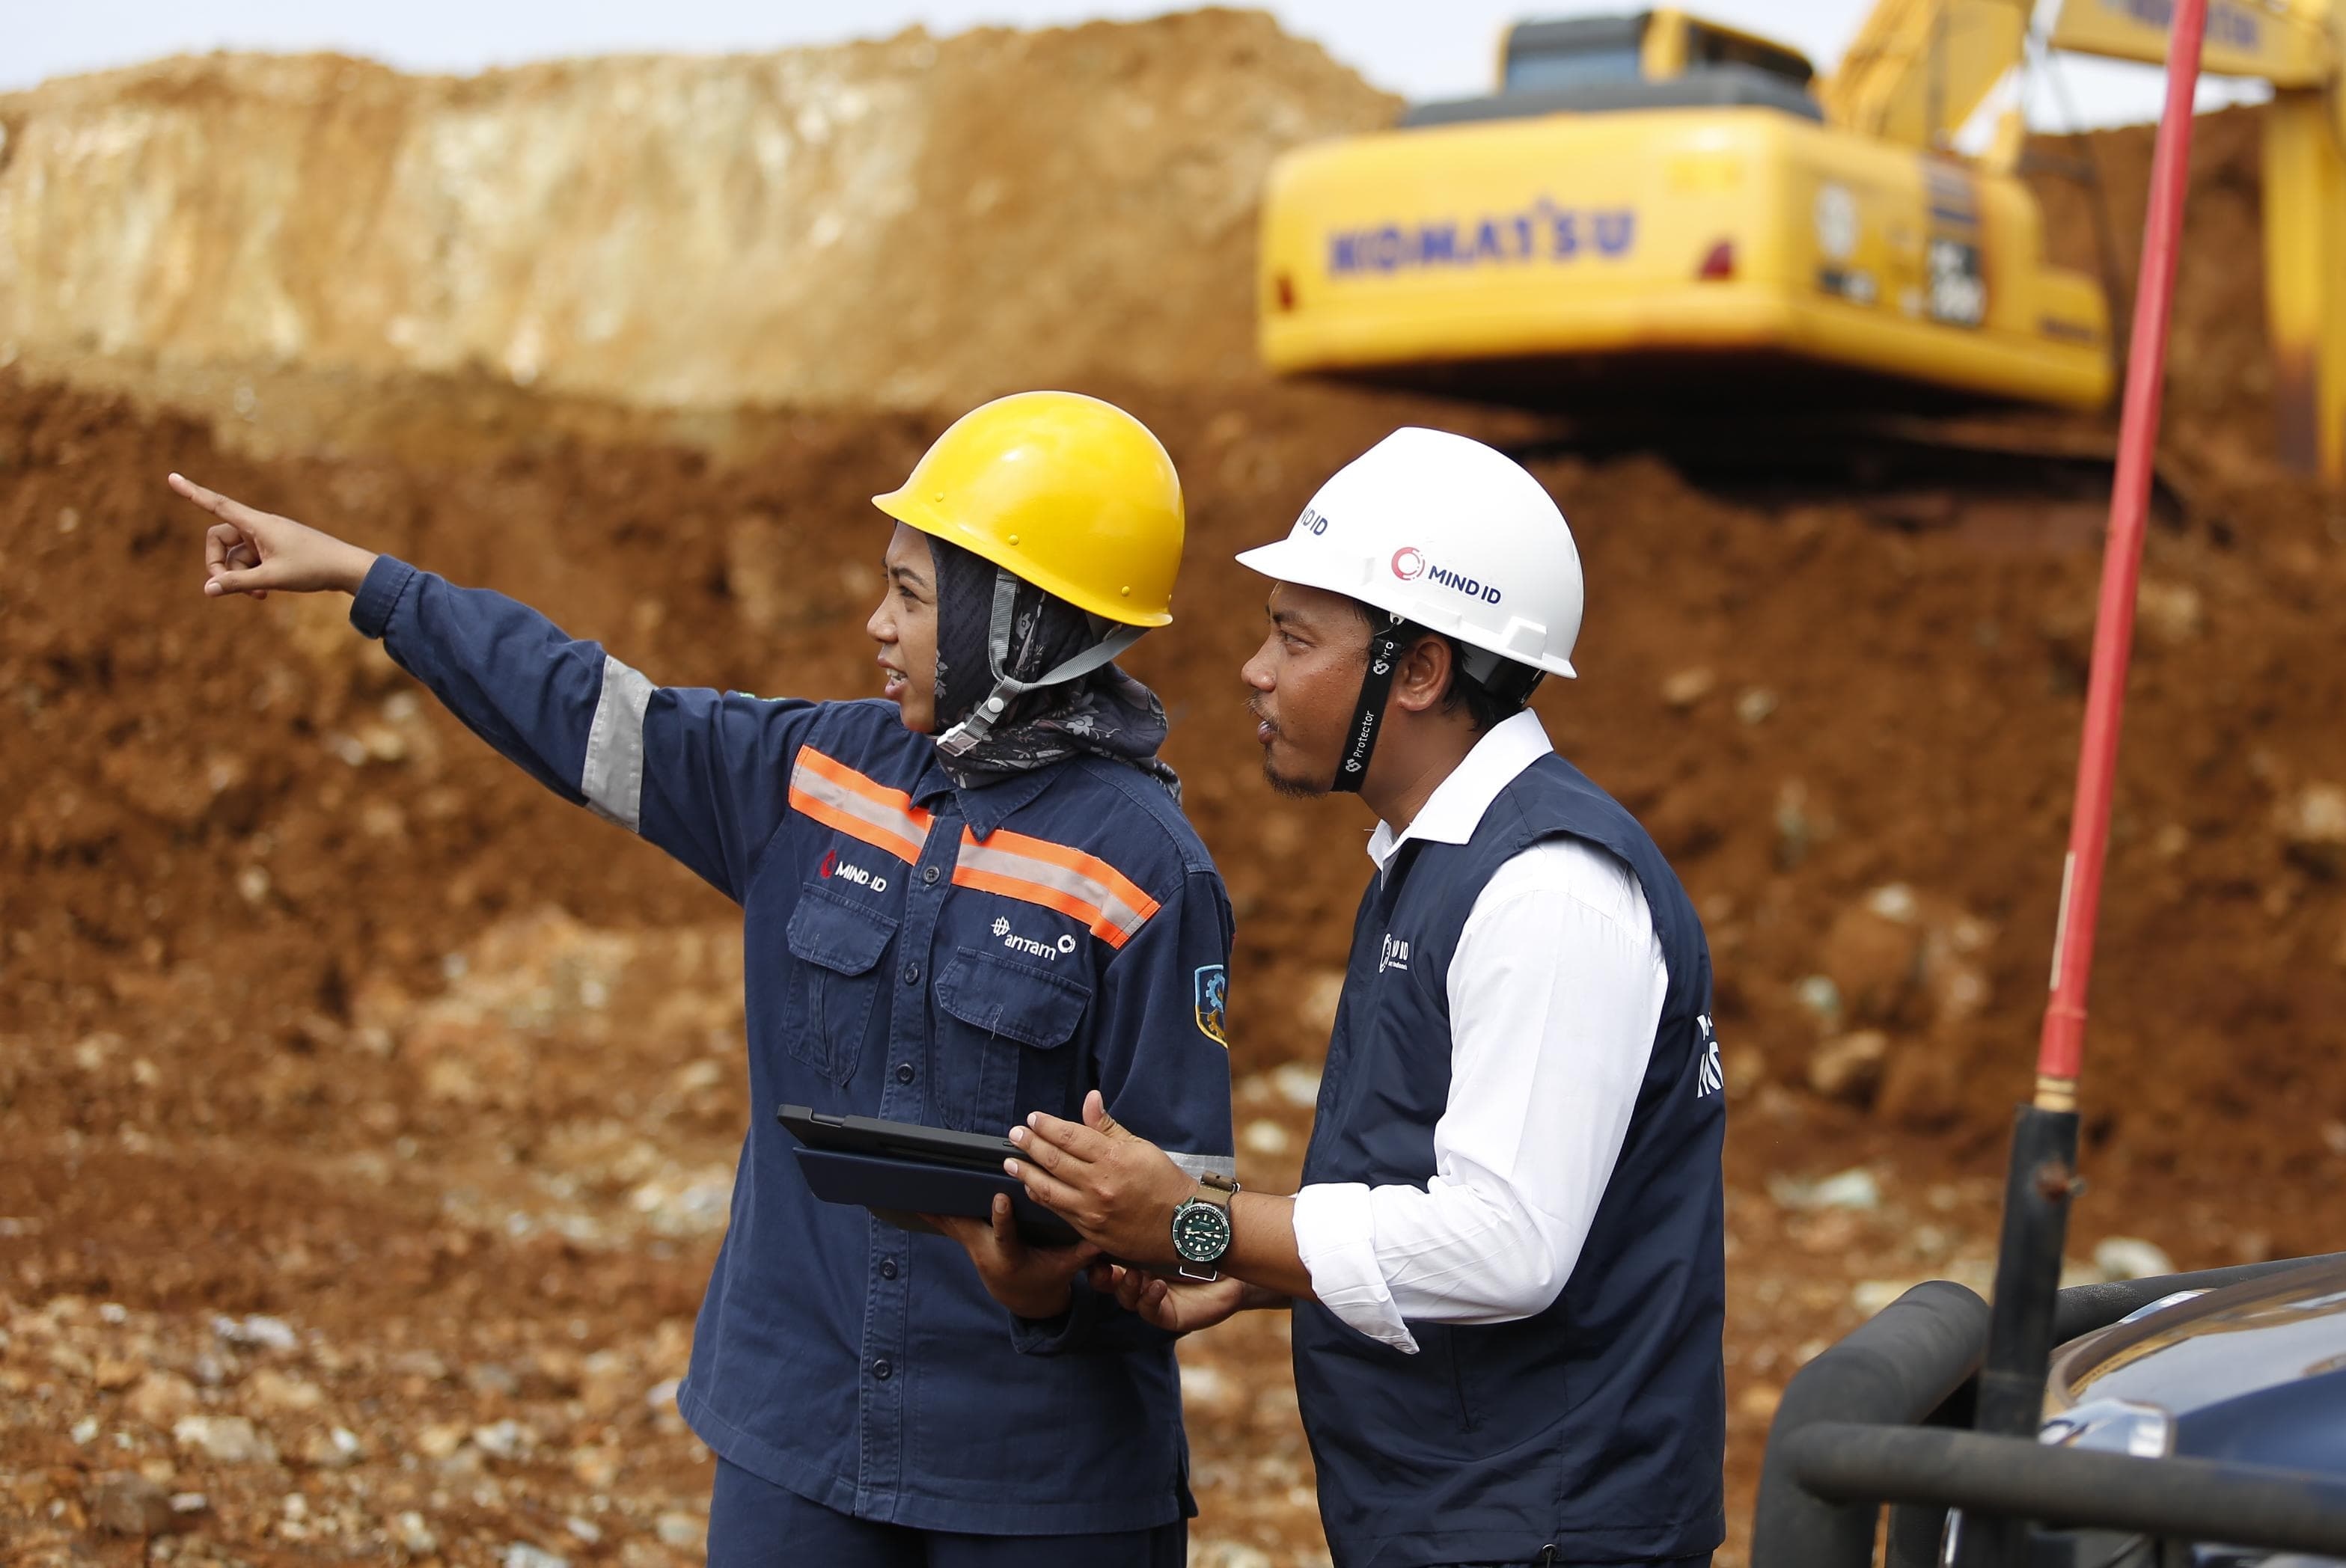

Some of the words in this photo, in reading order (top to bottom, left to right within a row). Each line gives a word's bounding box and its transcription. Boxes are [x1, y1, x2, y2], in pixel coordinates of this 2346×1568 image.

[1330, 197, 1636, 277] KOMATSU
[1310, 515, 1328, 536] ID
[1429, 565, 1480, 595] MIND
[1480, 585, 1501, 604] ID
[1353, 710, 1375, 758] Protector
[834, 860, 869, 885] MIND
[870, 875, 887, 892] ID
